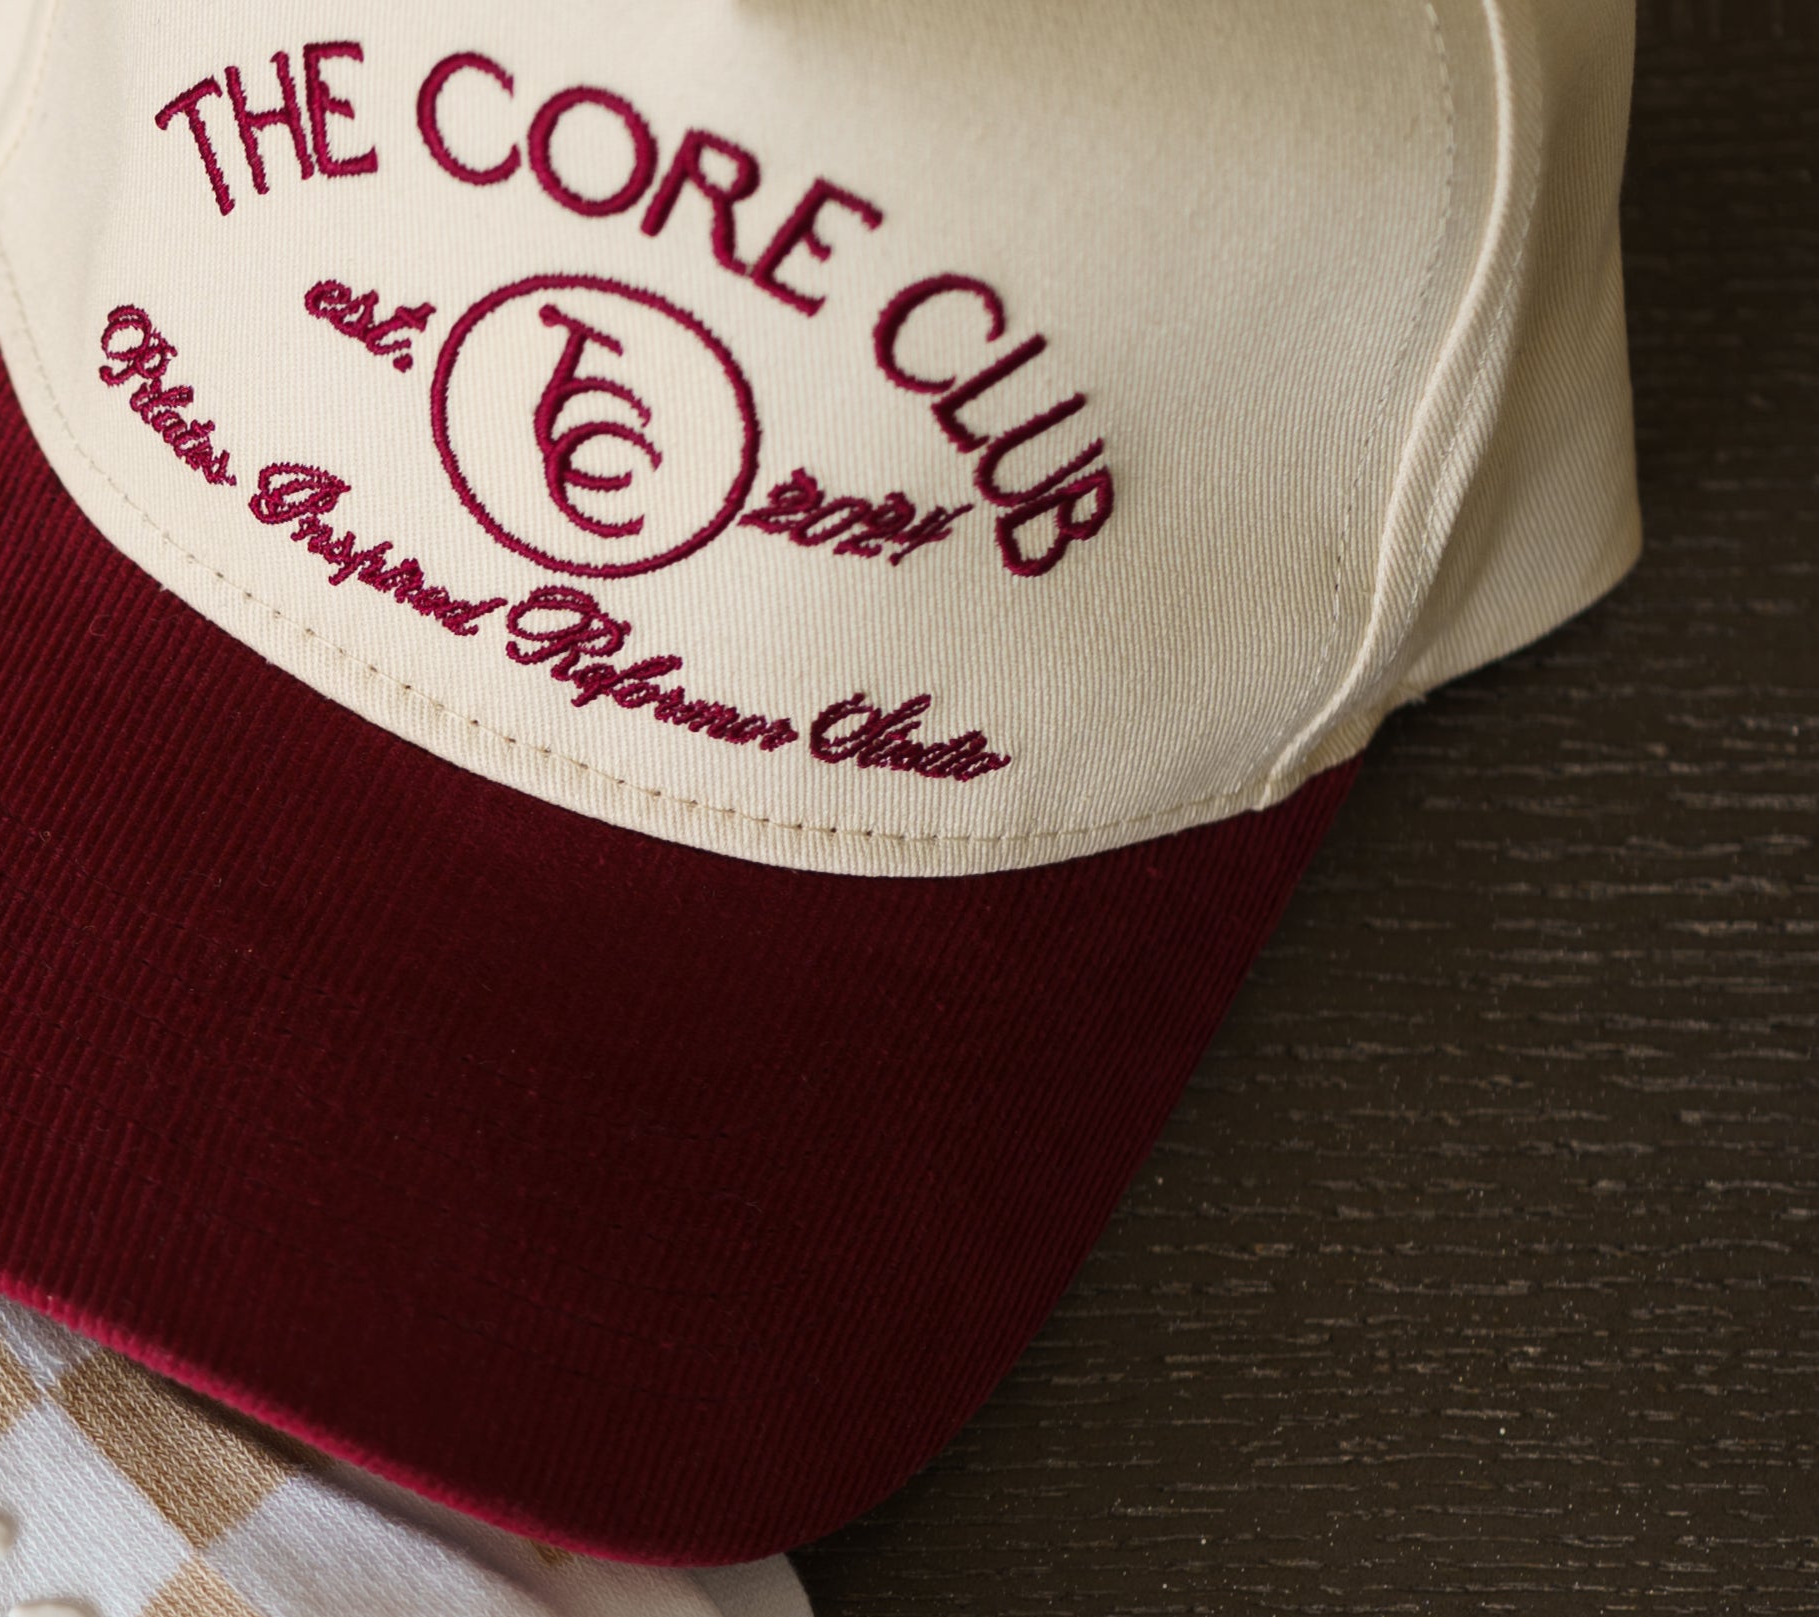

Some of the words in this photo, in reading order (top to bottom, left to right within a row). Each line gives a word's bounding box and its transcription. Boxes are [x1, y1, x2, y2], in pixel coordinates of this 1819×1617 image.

[98, 304, 238, 488] Pilates
[247, 462, 510, 638] Inspired
[505, 584, 800, 754] Reformer
[809, 691, 1013, 784] Studio
[154, 40, 380, 218] THE
[415, 51, 884, 318] CORE
[871, 272, 1113, 579] CLUB
[303, 279, 437, 374] est.
